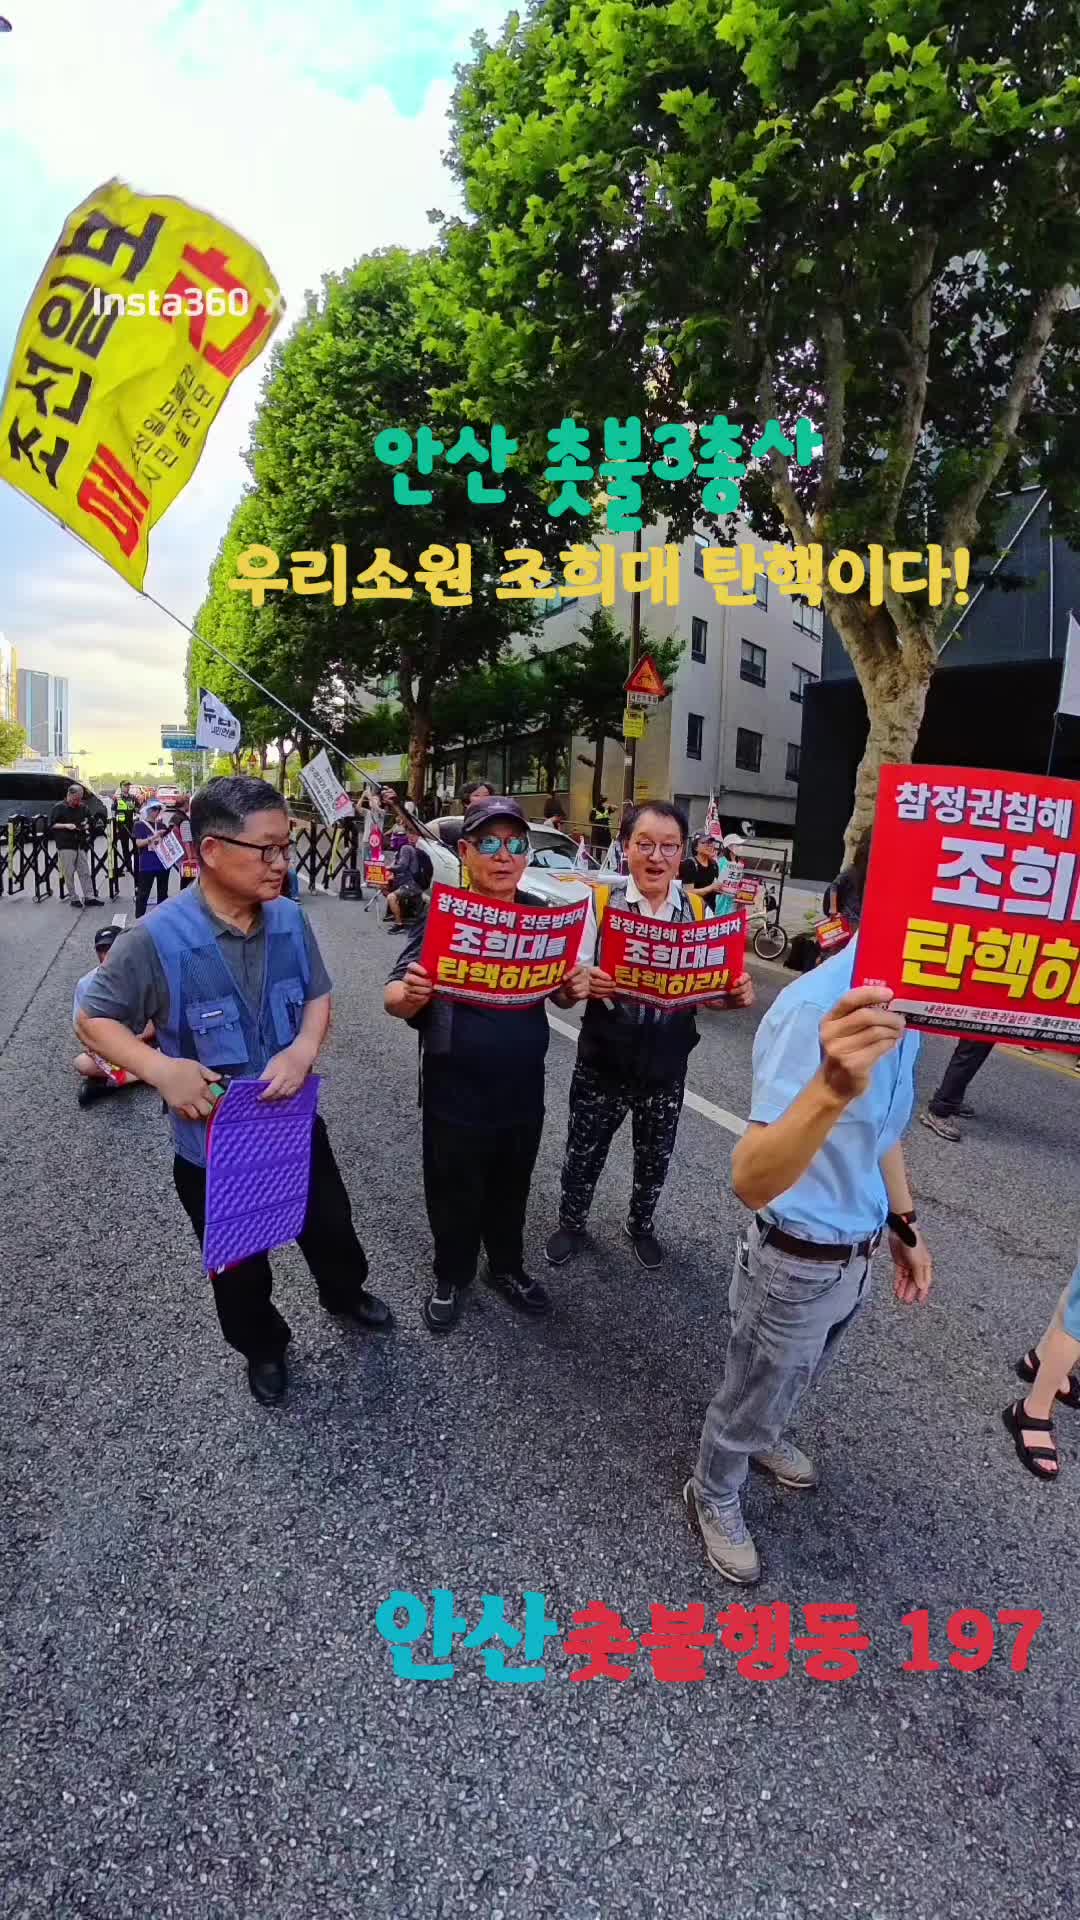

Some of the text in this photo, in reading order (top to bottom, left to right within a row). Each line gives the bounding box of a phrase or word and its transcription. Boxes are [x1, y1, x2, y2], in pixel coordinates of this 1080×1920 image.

[8, 208, 167, 489] 조선일보
[895, 782, 1073, 839] 참정권침해
[931, 835, 1080, 922] 조희
[436, 891, 586, 930] 참정권침해 전문범죄자
[609, 914, 742, 944] 참정권침해 전문범죄자
[448, 922, 568, 962] 조희대를
[623, 938, 725, 970] 조희대를
[437, 955, 567, 990] 탄핵하라!
[614, 964, 730, 996] 탄핵하라!
